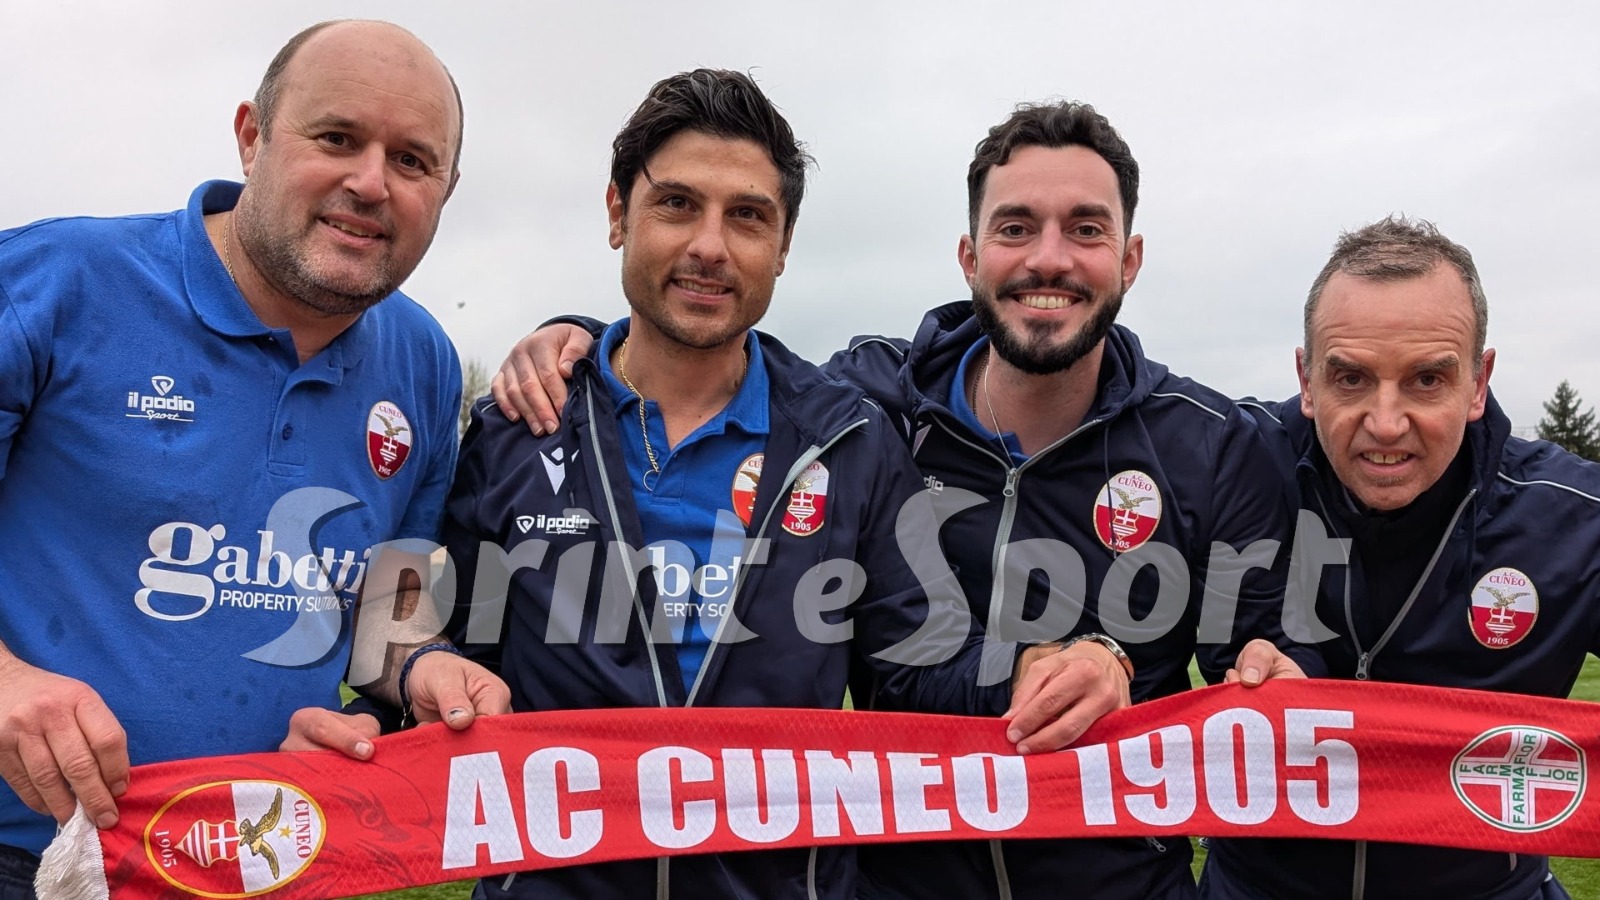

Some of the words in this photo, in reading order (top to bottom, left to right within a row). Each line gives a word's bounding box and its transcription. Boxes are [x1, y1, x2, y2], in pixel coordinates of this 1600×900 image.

[128, 392, 139, 408] il
[141, 395, 195, 412] podio
[1118, 477, 1153, 492] CUNEO
[536, 514, 546, 529] il
[546, 514, 590, 531] podio
[790, 521, 812, 531] 1905
[134, 521, 372, 622] gabetti
[1489, 574, 1526, 587] CUNEO
[220, 589, 304, 612] PROPERTY
[1487, 636, 1510, 645] 1905
[442, 747, 604, 870] AC
[637, 745, 1029, 850] CUNEO
[1056, 707, 1359, 826] 1905
[294, 799, 313, 859] CUNEO
[154, 829, 178, 868] 1905
